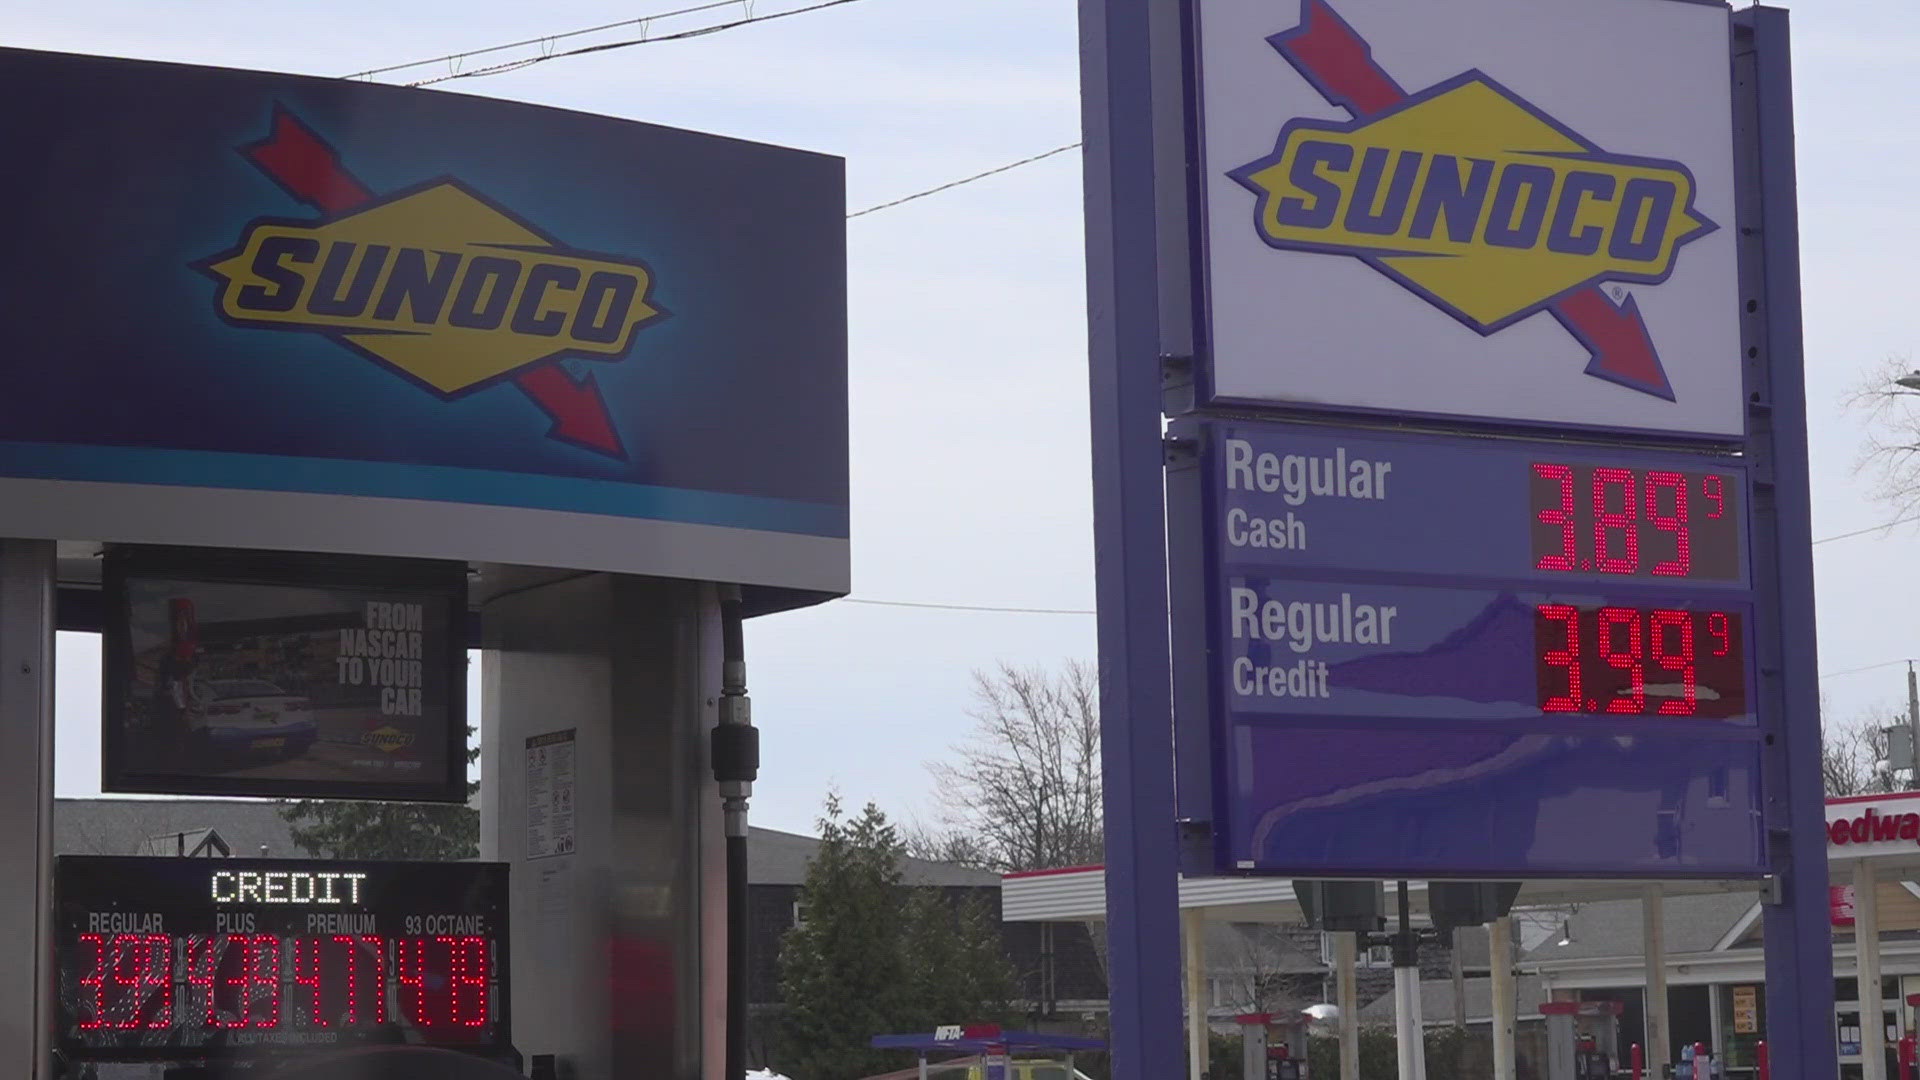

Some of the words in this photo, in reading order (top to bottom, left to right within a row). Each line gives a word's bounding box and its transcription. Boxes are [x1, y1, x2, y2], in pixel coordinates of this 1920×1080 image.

[1275, 140, 1677, 262] SUNOCO
[236, 236, 638, 344] SUNOCO
[1225, 438, 1392, 506] Regular
[1227, 508, 1306, 550] Cash
[1533, 463, 1690, 577] 3.89
[1703, 475, 1724, 519] 9
[366, 601, 422, 631] FROM
[1230, 587, 1397, 653] Regular
[340, 629, 422, 659] NASCAR
[1537, 605, 1696, 716] 3.99
[1708, 612, 1729, 657] 9
[336, 656, 363, 685] TO
[368, 658, 422, 687] YOUR
[1233, 656, 1330, 698] Credit
[381, 687, 422, 716] CAR
[1826, 807, 1920, 846] edwa
[211, 871, 367, 904] CREDIT
[89, 912, 164, 934] REGULAR
[216, 912, 256, 933] PLUS
[307, 914, 376, 934] PREMIUM
[405, 915, 426, 934] 93
[427, 915, 484, 935] OCTANE
